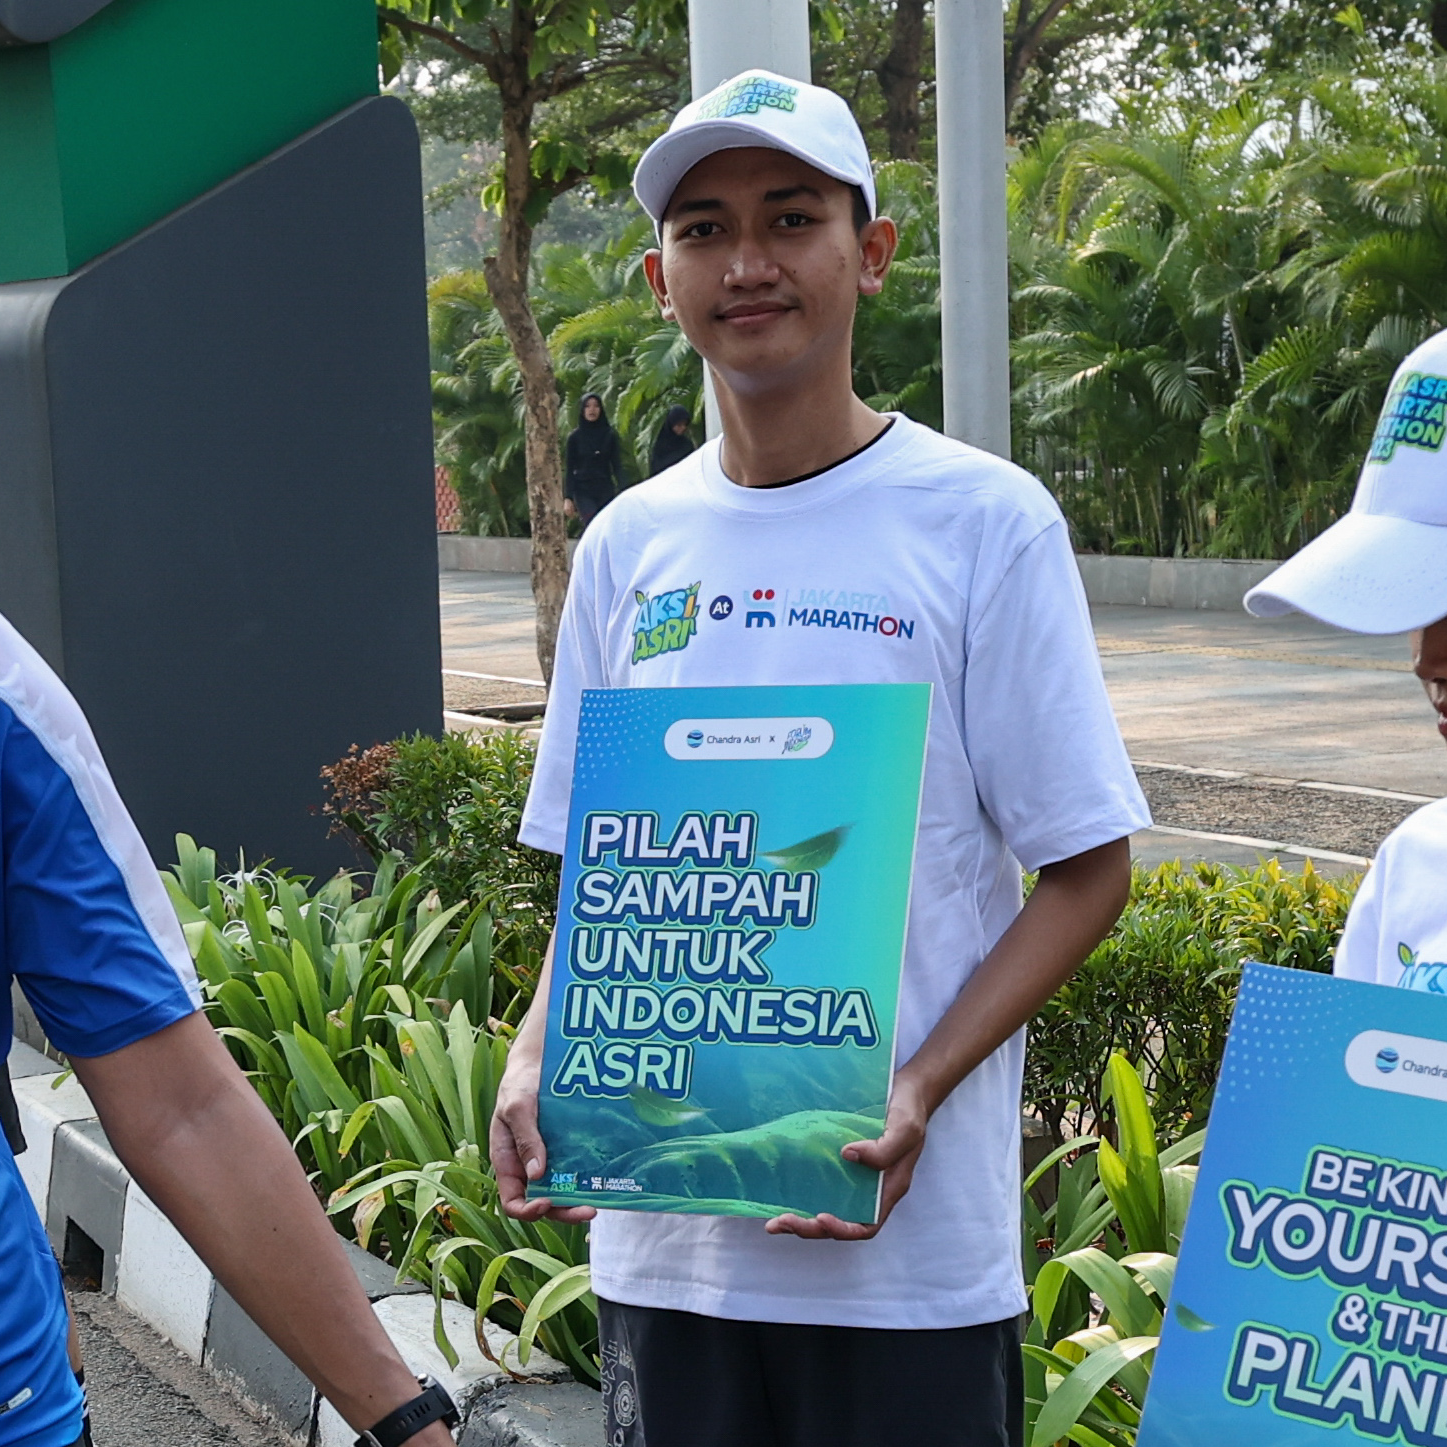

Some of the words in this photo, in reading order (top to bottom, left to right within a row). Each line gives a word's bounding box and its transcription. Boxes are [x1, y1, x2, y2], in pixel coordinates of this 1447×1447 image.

[633, 587, 699, 633] AKSI
[712, 602, 731, 616] At
[792, 589, 890, 614] JAKARTA
[632, 616, 697, 665] ASRI
[788, 608, 915, 639] MARATHON
[706, 735, 742, 744] Chandra
[744, 735, 761, 744] Asri
[587, 815, 752, 860] PILAH
[579, 873, 813, 919] SAMPAH
[576, 929, 772, 977] UNTUK
[568, 986, 877, 1038] INDONESIA
[560, 1043, 687, 1091] ASRI
[1310, 1152, 1373, 1199] BE
[1337, 1294, 1369, 1335] &
